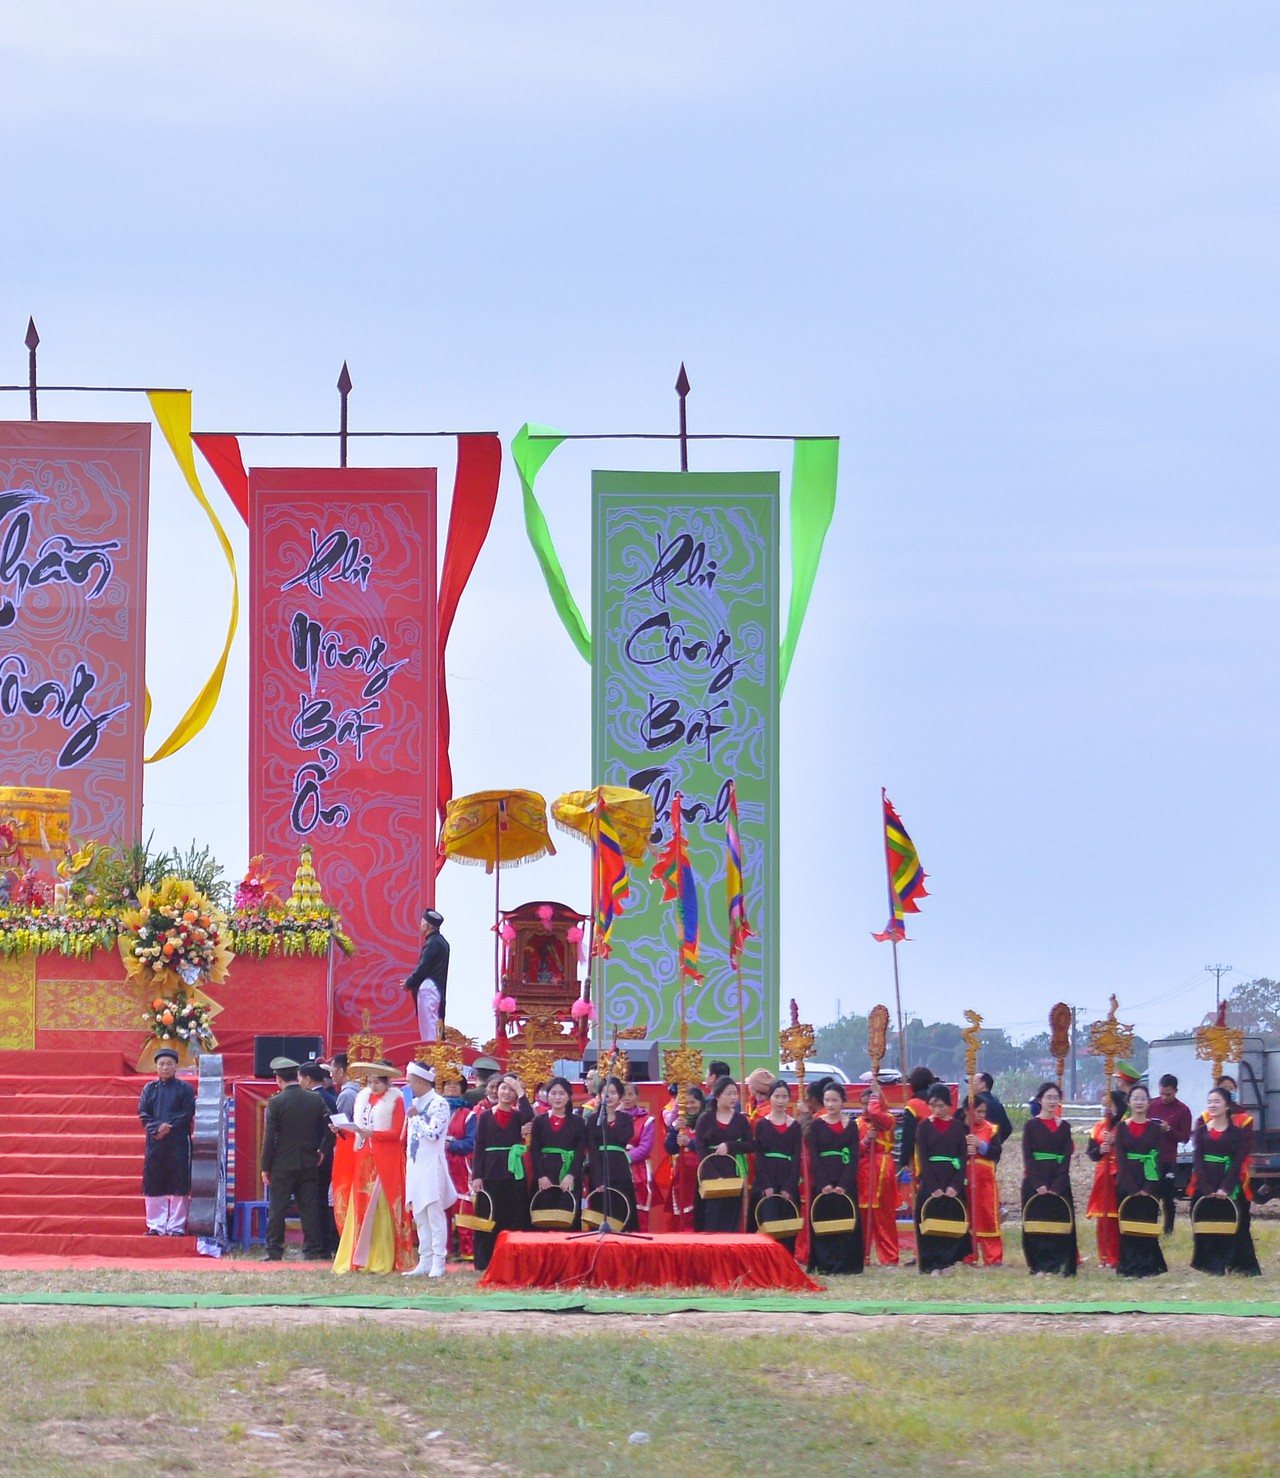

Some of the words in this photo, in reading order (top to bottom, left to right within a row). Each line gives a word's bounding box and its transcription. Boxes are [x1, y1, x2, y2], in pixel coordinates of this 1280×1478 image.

[281, 529, 370, 597] Phi
[628, 533, 717, 603] Phi
[292, 612, 408, 698] Nông
[626, 611, 751, 693] Công
[295, 696, 382, 760] Bất
[641, 694, 730, 763] Bất
[292, 749, 349, 834] Ổn
